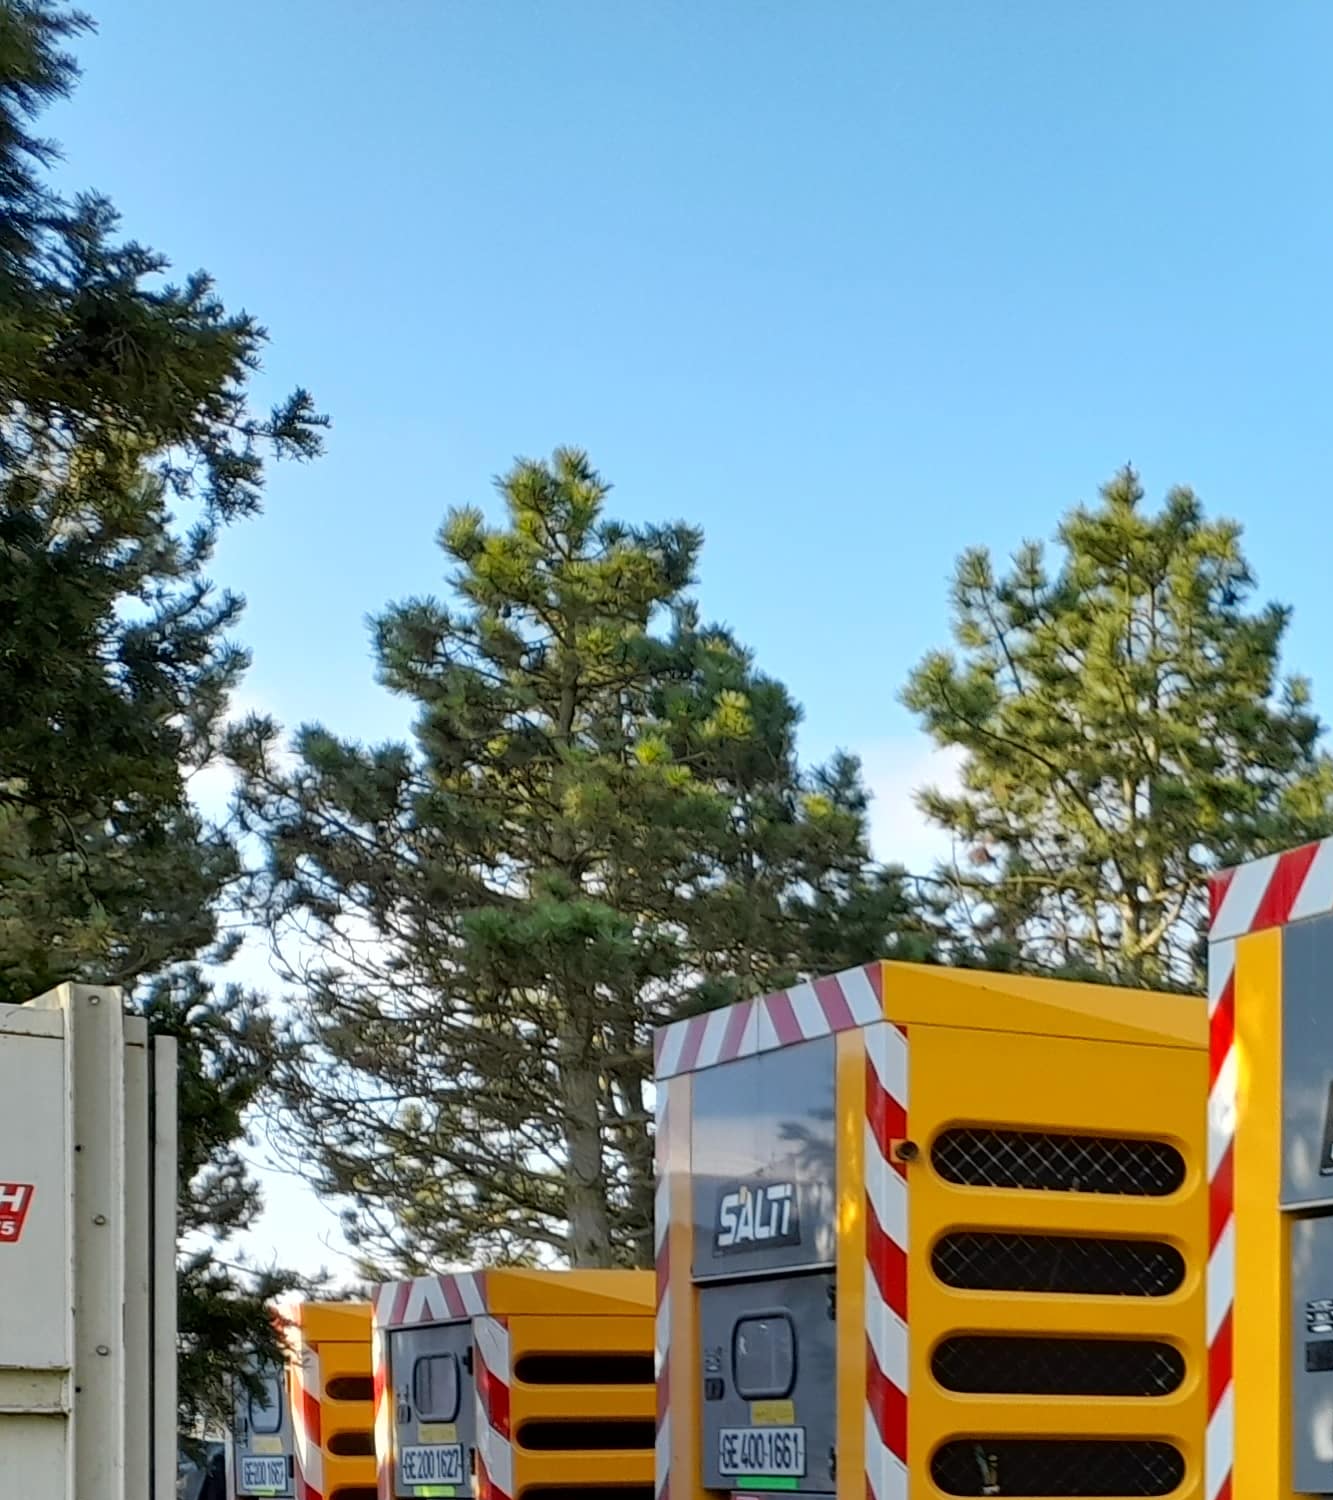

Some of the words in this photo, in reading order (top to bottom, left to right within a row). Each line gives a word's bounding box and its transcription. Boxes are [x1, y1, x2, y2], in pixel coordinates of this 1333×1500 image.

[722, 1434, 739, 1469] GE
[741, 1434, 765, 1469] 400
[768, 1433, 800, 1468] 1661
